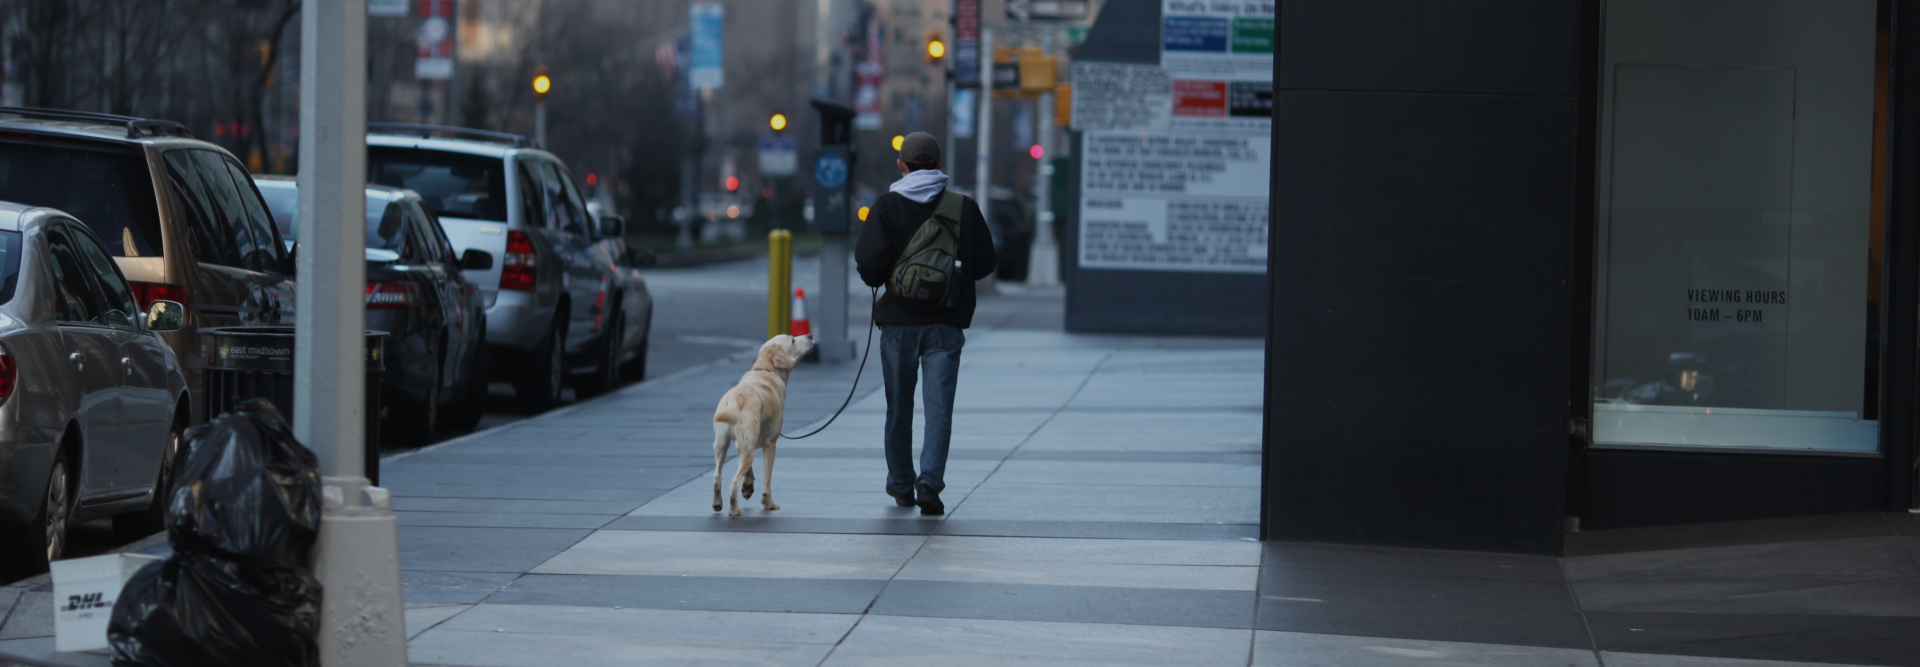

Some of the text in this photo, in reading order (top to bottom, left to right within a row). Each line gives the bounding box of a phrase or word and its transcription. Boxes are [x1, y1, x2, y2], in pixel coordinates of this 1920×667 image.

[1687, 289, 1786, 304] VIEWING HOURS
[1687, 308, 1719, 321] 10AM
[1736, 309, 1763, 322] 6PM
[230, 345, 290, 356] east midtown
[67, 592, 104, 611] DHL
